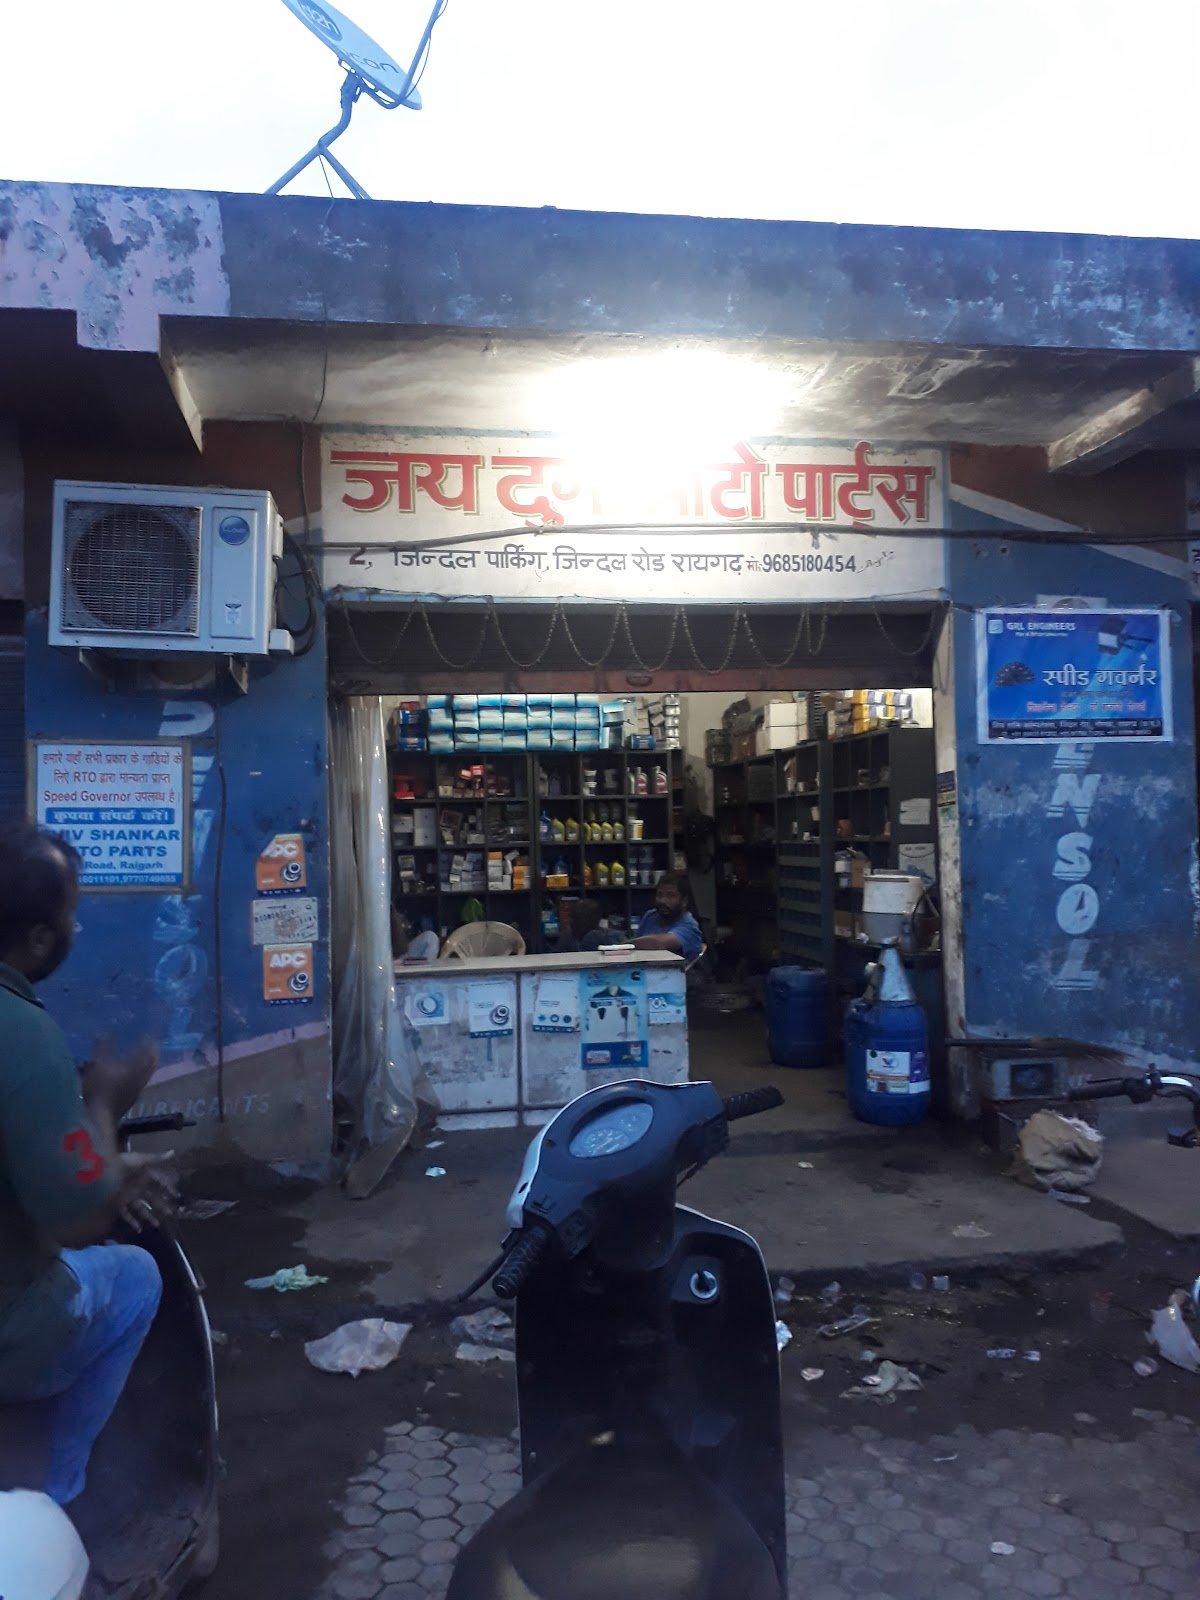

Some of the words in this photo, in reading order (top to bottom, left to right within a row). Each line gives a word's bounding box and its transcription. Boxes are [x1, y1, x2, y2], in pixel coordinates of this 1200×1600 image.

[330, 450, 484, 516] जय
[553, 545, 627, 573] जिन्दल
[632, 547, 665, 572] रोड
[671, 553, 744, 576] रायगढ़
[762, 553, 857, 573] 9685180454
[1042, 663, 1090, 686] स्पीड
[1095, 663, 1158, 687] गवर्नर
[73, 771, 96, 783] RTO
[43, 790, 77, 804] Speed
[81, 791, 131, 802] Governor
[90, 829, 180, 841] SHANKAR
[109, 845, 168, 857] PARTS
[62, 1128, 105, 1185] 3
